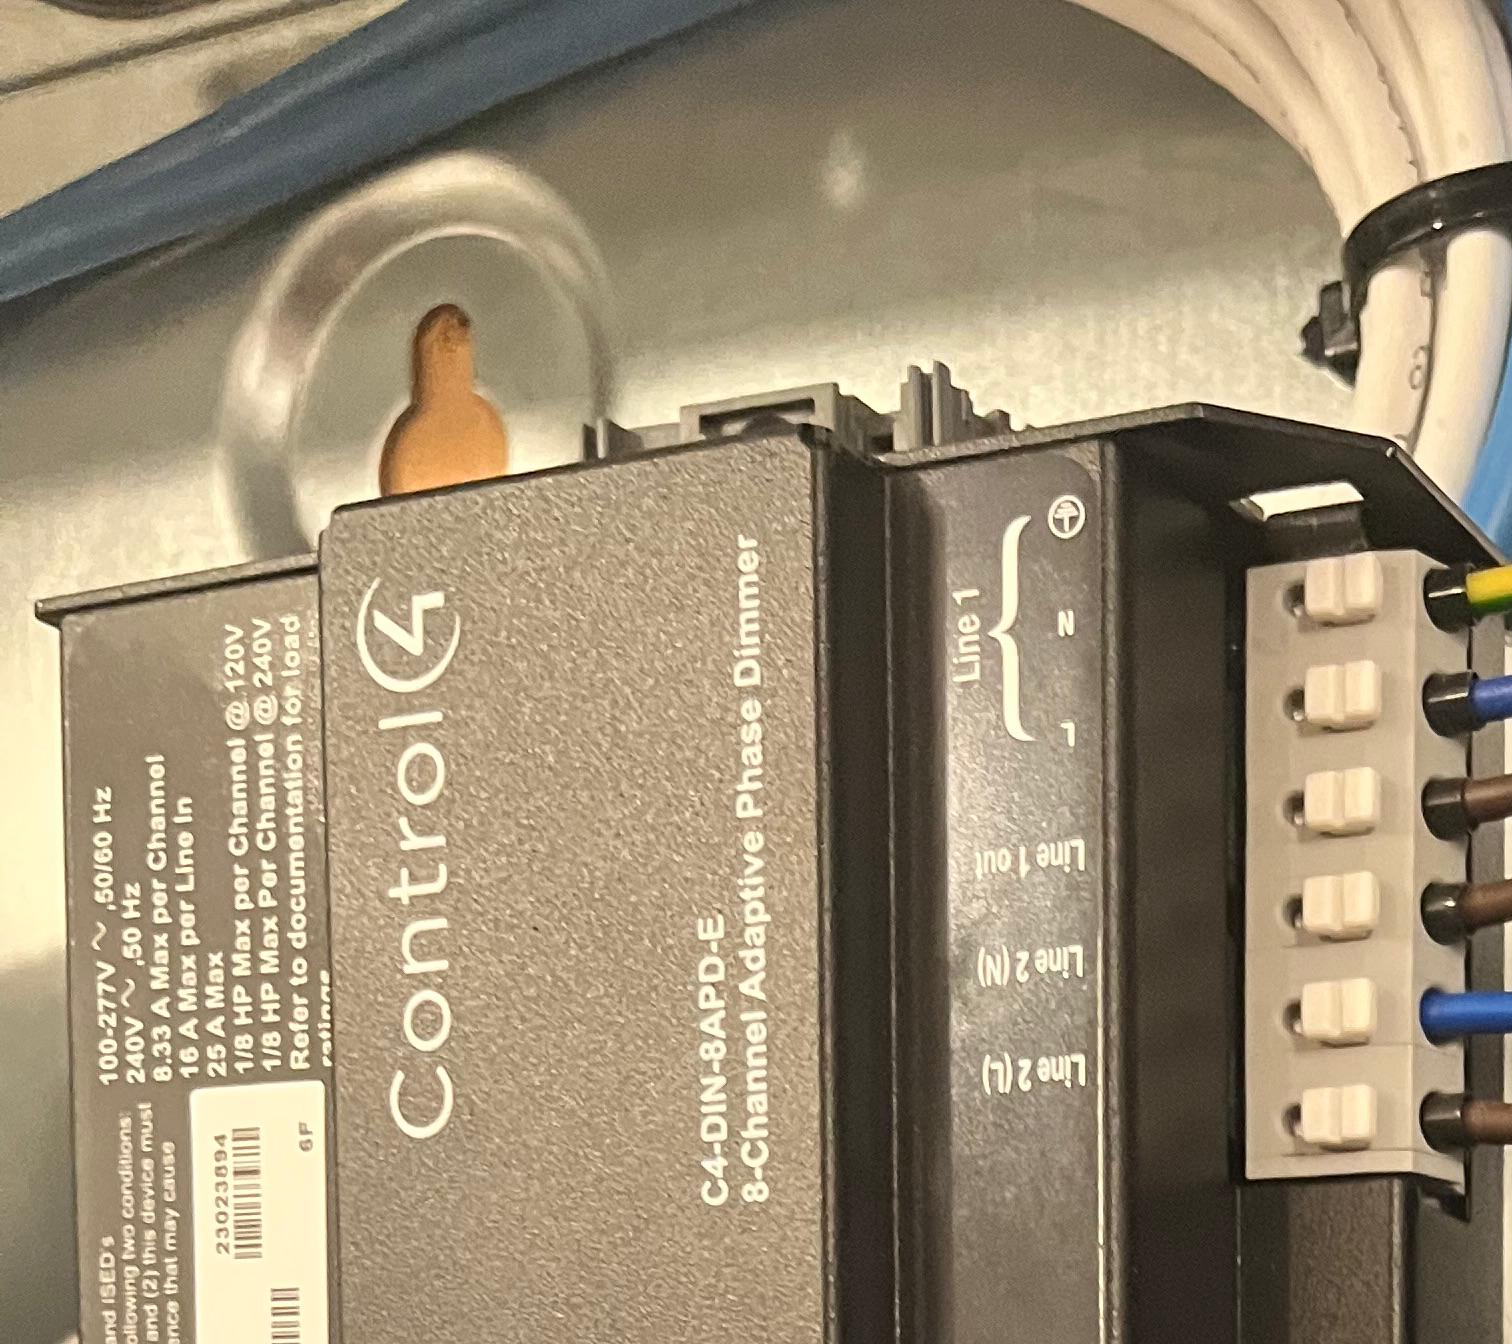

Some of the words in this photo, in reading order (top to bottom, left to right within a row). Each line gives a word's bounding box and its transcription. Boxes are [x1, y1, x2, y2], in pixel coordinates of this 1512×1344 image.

[732, 533, 761, 687] Dimmer
[951, 588, 980, 606] 1
[222, 624, 246, 693] 120V
[251, 618, 273, 688] 240V
[278, 613, 301, 677] load
[951, 613, 981, 683] Line
[224, 700, 249, 731] @
[253, 694, 278, 725] @
[280, 685, 304, 726] for
[1060, 721, 1076, 747] L
[734, 697, 764, 819] Phase
[92, 786, 112, 824] Hz
[144, 754, 167, 871] Channel
[172, 796, 193, 824] In
[225, 737, 249, 857] Channel
[252, 732, 277, 851] Channel
[174, 831, 195, 892] Line
[282, 733, 307, 949] documentation
[354, 577, 463, 1139] Control4
[1035, 838, 1086, 874] Line
[120, 882, 141, 919] Hz
[151, 878, 173, 924] per
[233, 863, 255, 911] per
[257, 858, 278, 908] Per
[179, 899, 201, 946] per
[735, 830, 772, 1002] Adaptive
[149, 932, 170, 990] Max
[231, 918, 252, 977] Max
[258, 915, 280, 974] Max
[977, 942, 1010, 988] (N)
[1015, 950, 1030, 983] 2
[1034, 944, 1084, 979] Line
[176, 954, 198, 1012] Max
[204, 951, 225, 1009] Max
[288, 957, 308, 986] to
[95, 960, 119, 1086] 100-277V
[150, 996, 171, 1018] A
[205, 1015, 226, 1038] A
[232, 984, 254, 1026] HP
[260, 983, 281, 1023] HP
[123, 1016, 146, 1084] 240V
[178, 1017, 199, 1040] A
[260, 1030, 282, 1072] 1/8
[287, 993, 311, 1070] Refer
[150, 1024, 173, 1082] 8.33
[178, 1046, 200, 1079] 16
[206, 1043, 227, 1078] 25
[233, 1033, 255, 1074] 1/8
[696, 914, 729, 1206] C4-DIN-8APD-E
[982, 1051, 1013, 1096] (L)
[1017, 1058, 1032, 1092] 2
[1036, 1053, 1086, 1089] Line
[739, 1010, 770, 1203] 8-Channel
